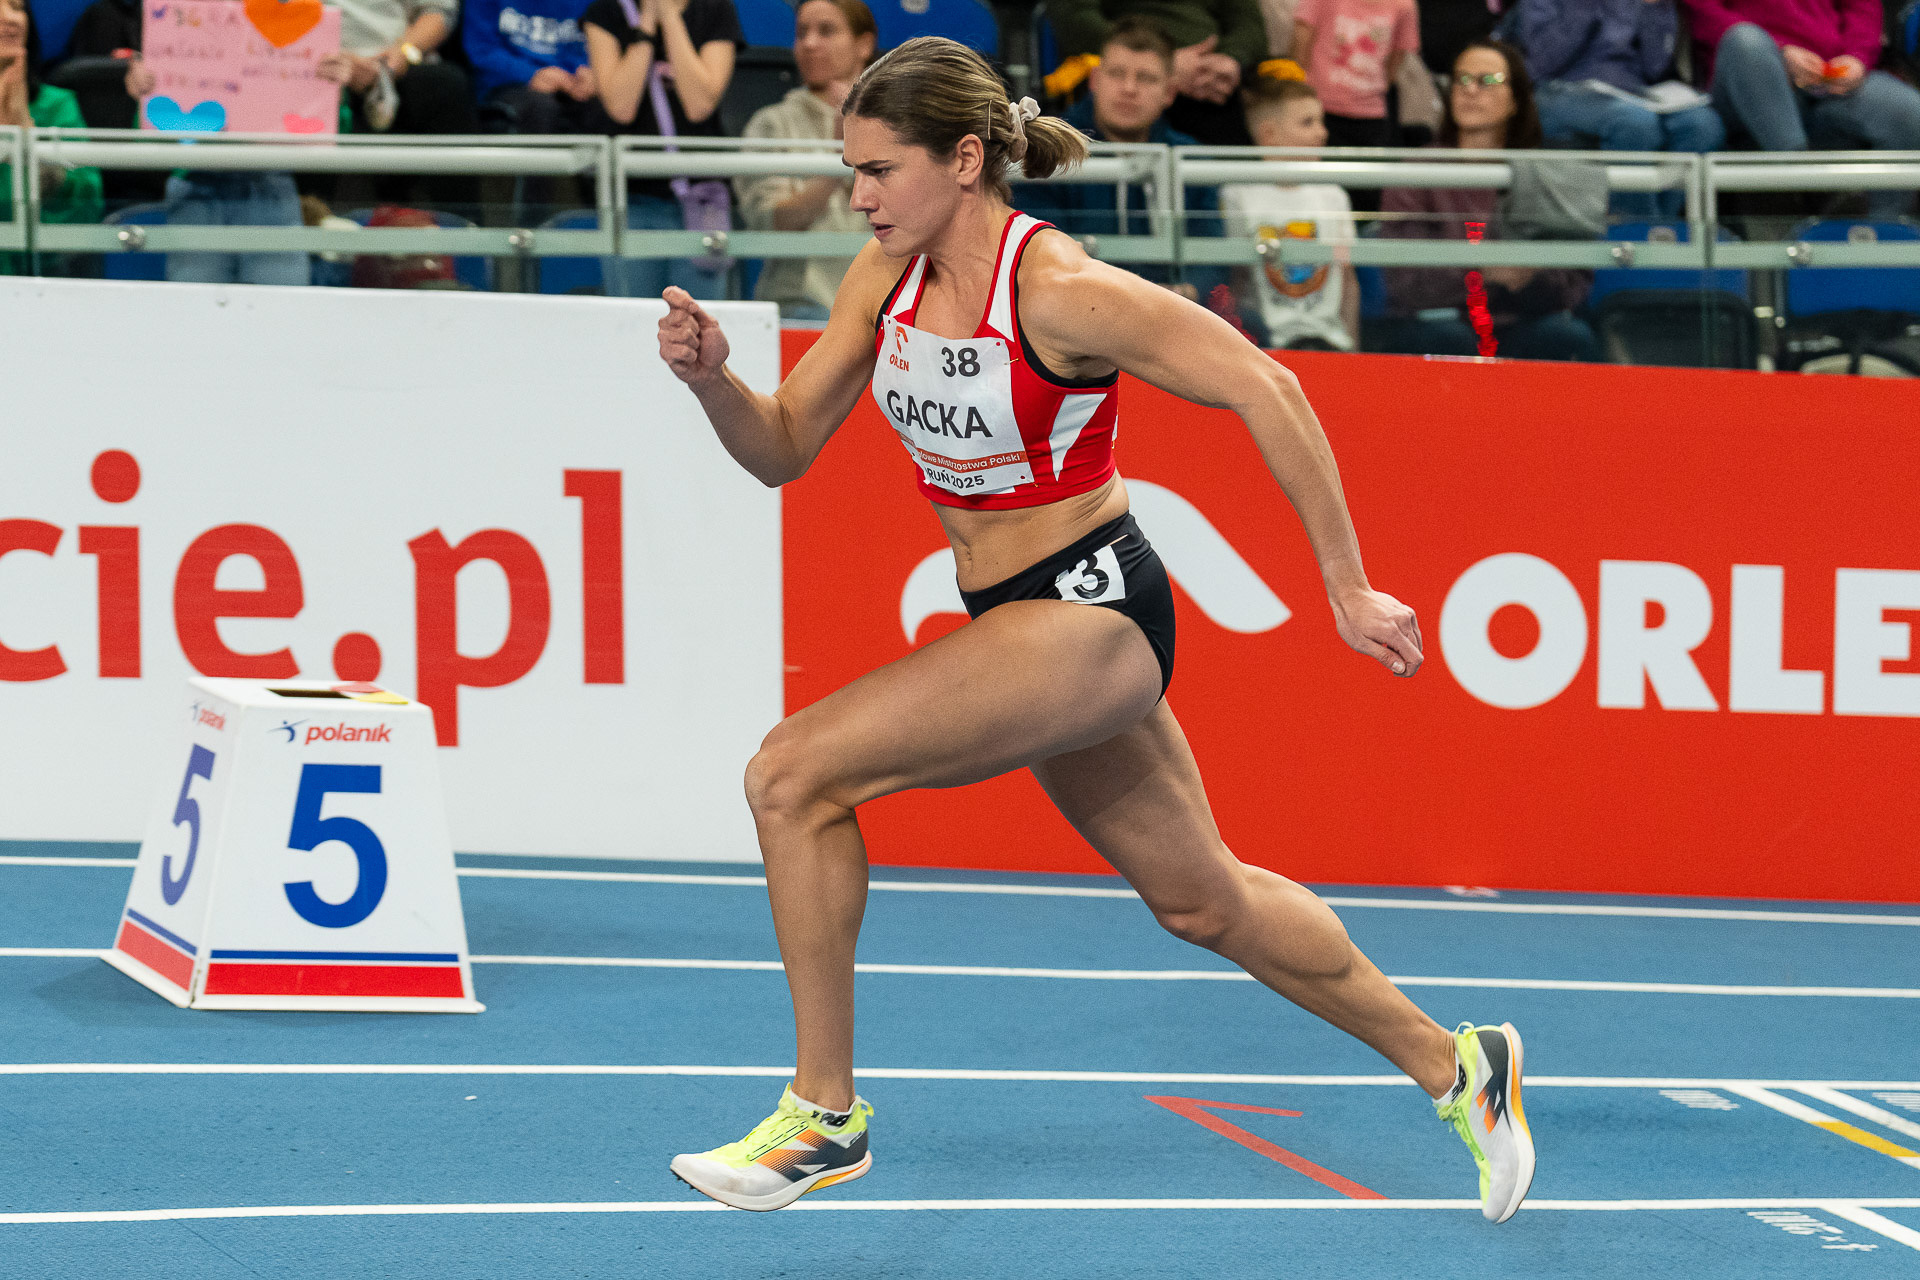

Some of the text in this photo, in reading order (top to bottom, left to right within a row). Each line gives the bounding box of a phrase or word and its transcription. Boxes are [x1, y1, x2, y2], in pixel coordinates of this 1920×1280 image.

[889, 353, 909, 372] ORLEN
[941, 346, 981, 378] 38
[886, 389, 994, 439] GACKA
[925, 467, 985, 489] RUŃ 2025
[937, 456, 988, 471] Mistrzostwa
[989, 453, 1021, 466] Polski
[0, 449, 625, 747] cie.pl
[1072, 555, 1109, 599] 3
[1439, 552, 1920, 717] ORLE
[304, 722, 393, 745] polanik
[160, 743, 216, 906] 5
[283, 763, 388, 928] 5
